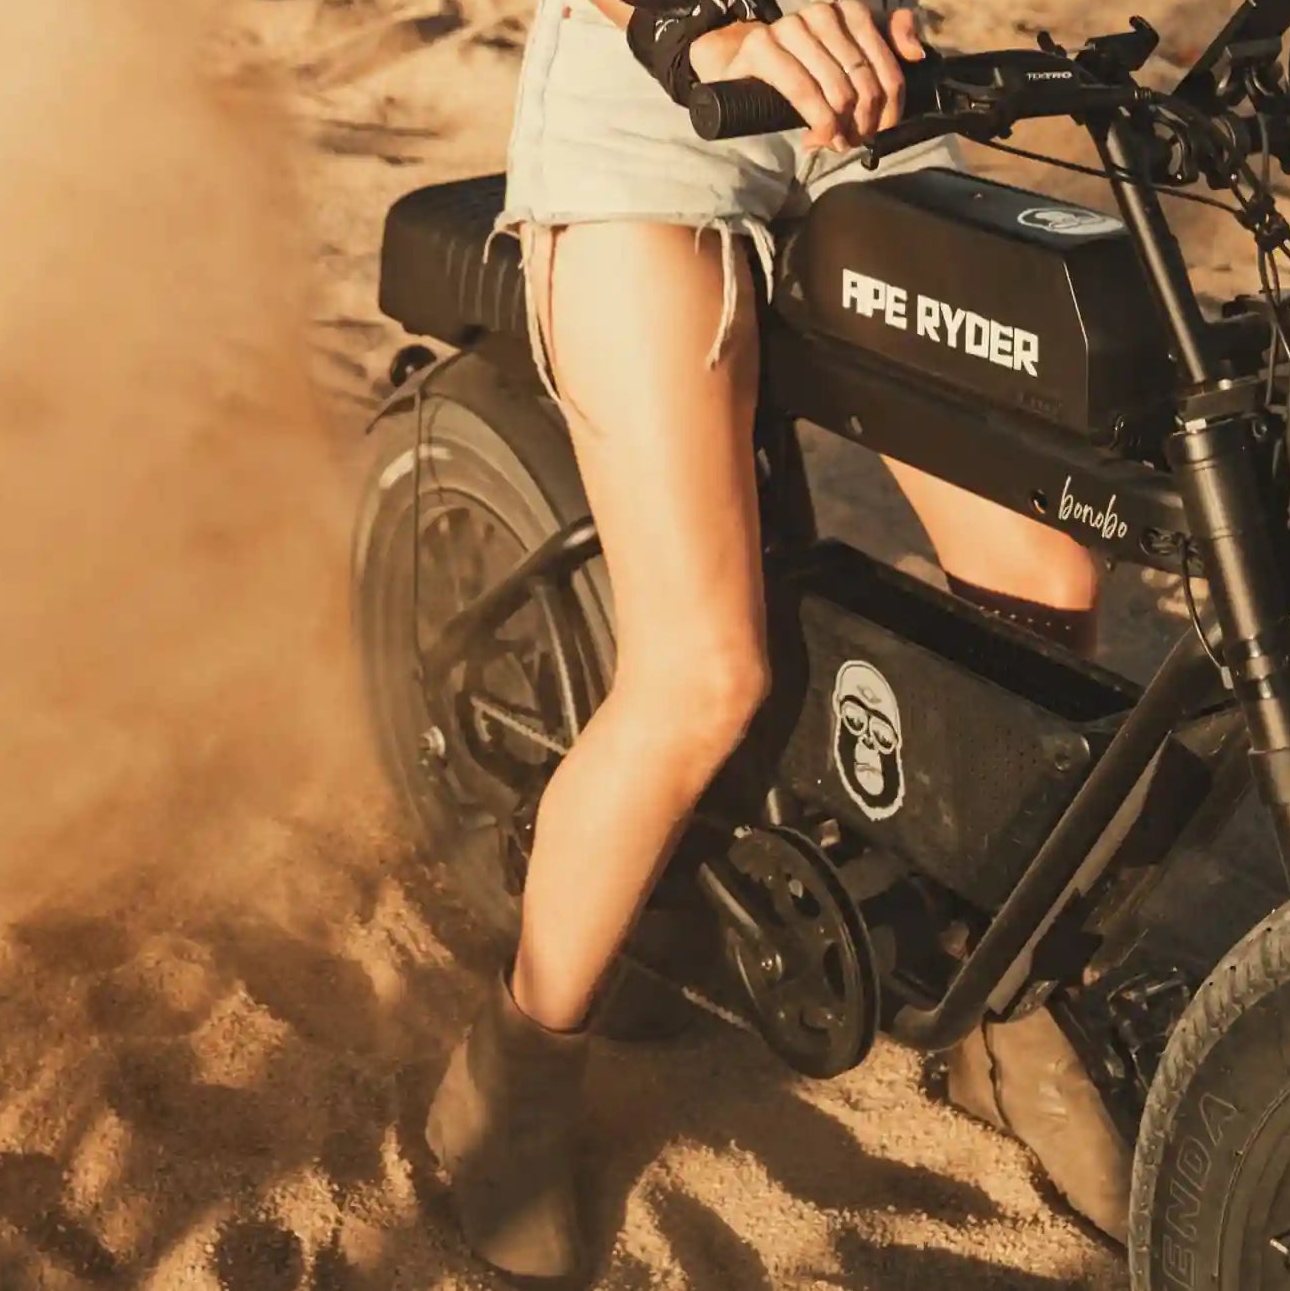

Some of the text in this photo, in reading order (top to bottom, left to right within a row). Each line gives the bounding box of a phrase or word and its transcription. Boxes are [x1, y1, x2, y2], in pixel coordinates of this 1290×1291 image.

[842, 268, 1039, 377] APE RYDER
[1058, 475, 1127, 539] bonobo
[1163, 1093, 1237, 1291] ENDA
